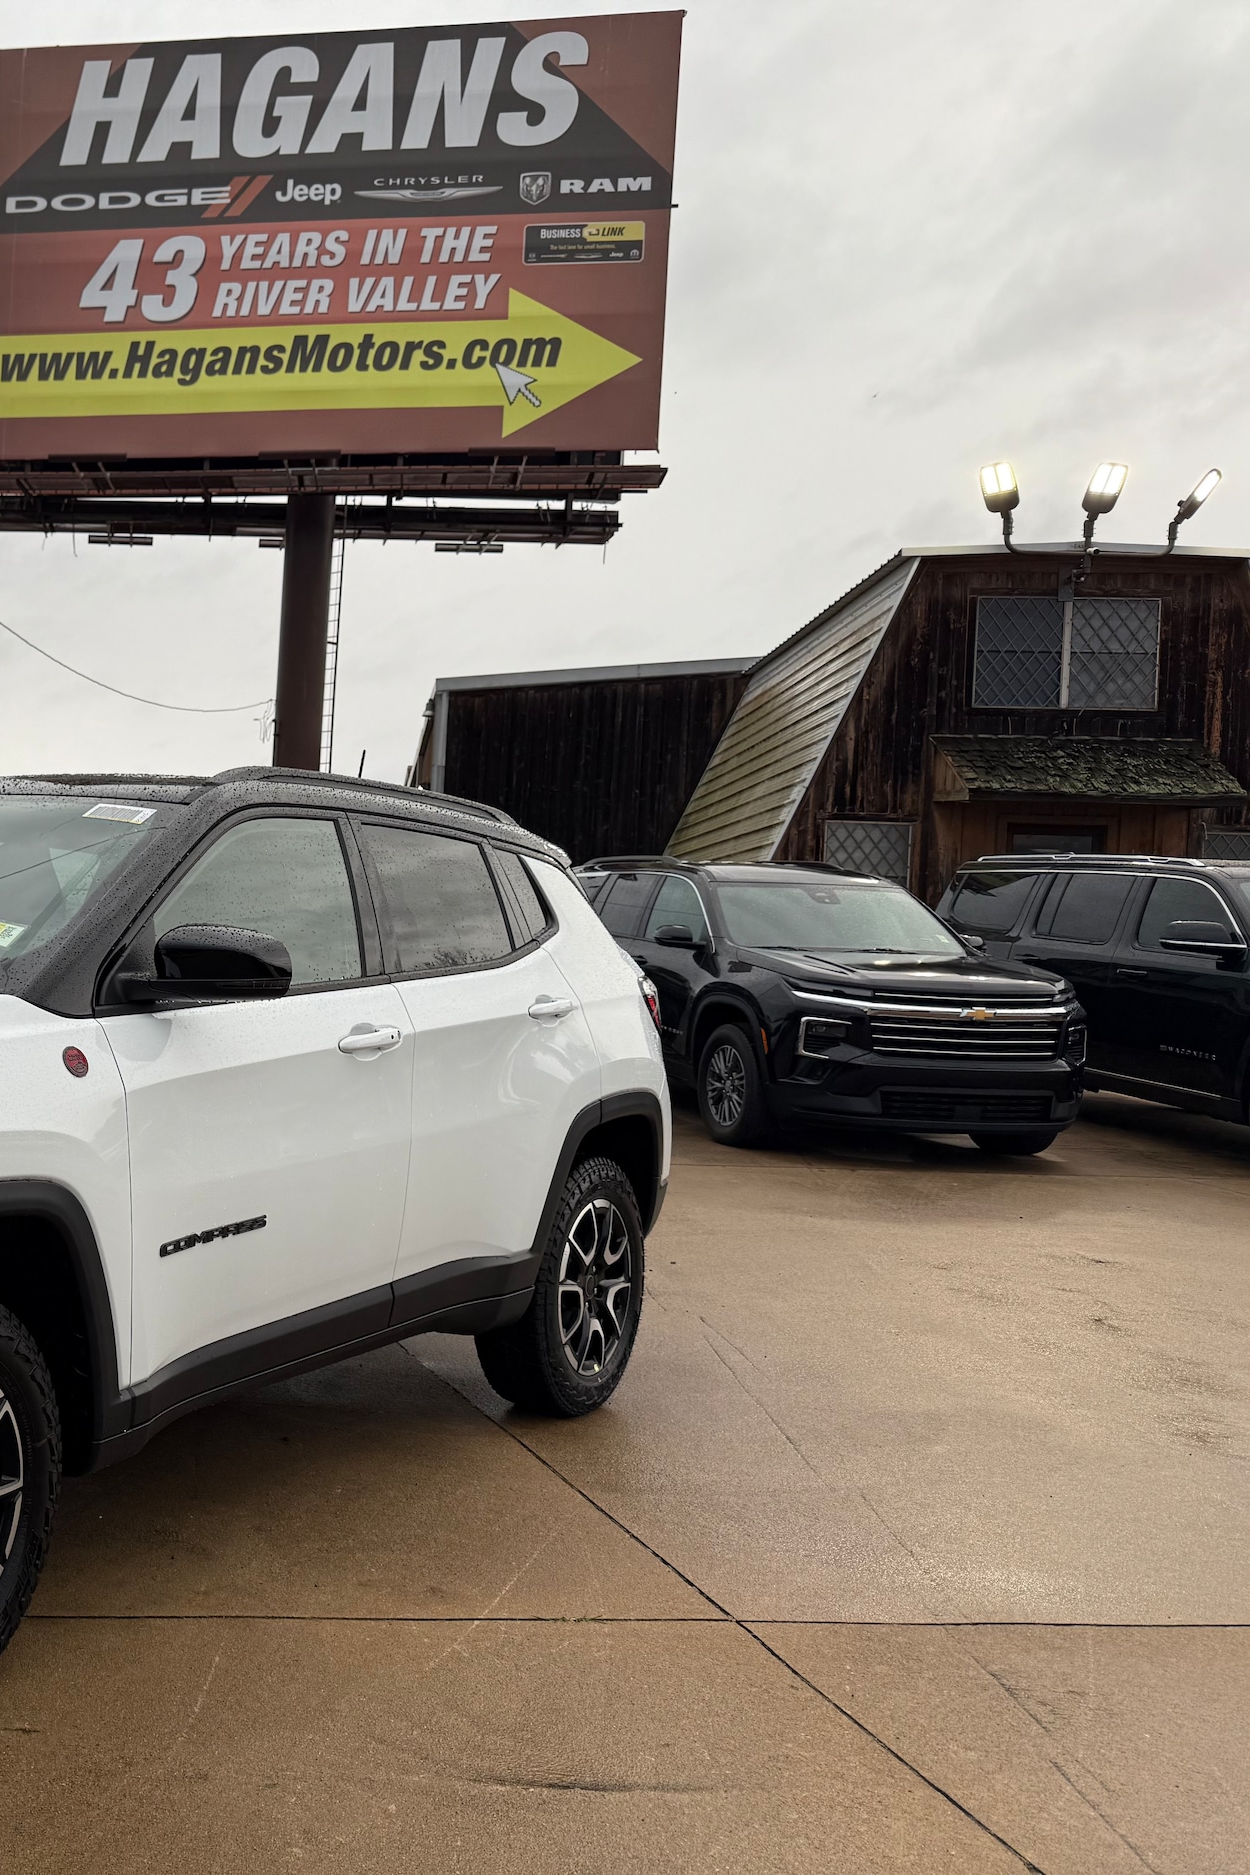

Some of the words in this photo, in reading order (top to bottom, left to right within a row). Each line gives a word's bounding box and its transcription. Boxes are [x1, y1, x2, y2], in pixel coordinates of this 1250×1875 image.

[59, 31, 590, 166] HAGANS
[5, 185, 232, 214] DODGE
[275, 179, 342, 205] Jeep
[373, 174, 484, 187] CHRYSLER
[560, 176, 652, 194] RAM
[219, 229, 348, 271] YEARS
[359, 228, 407, 266] IN
[419, 225, 498, 264] THE
[540, 228, 581, 239] BUSINESS
[601, 226, 626, 237] LINK
[78, 233, 207, 323] 43
[212, 278, 331, 318] RIVER
[346, 273, 503, 314] VALLEY
[0, 333, 562, 387] www.HagansMotors.com
[159, 1214, 268, 1258] COMPASS
